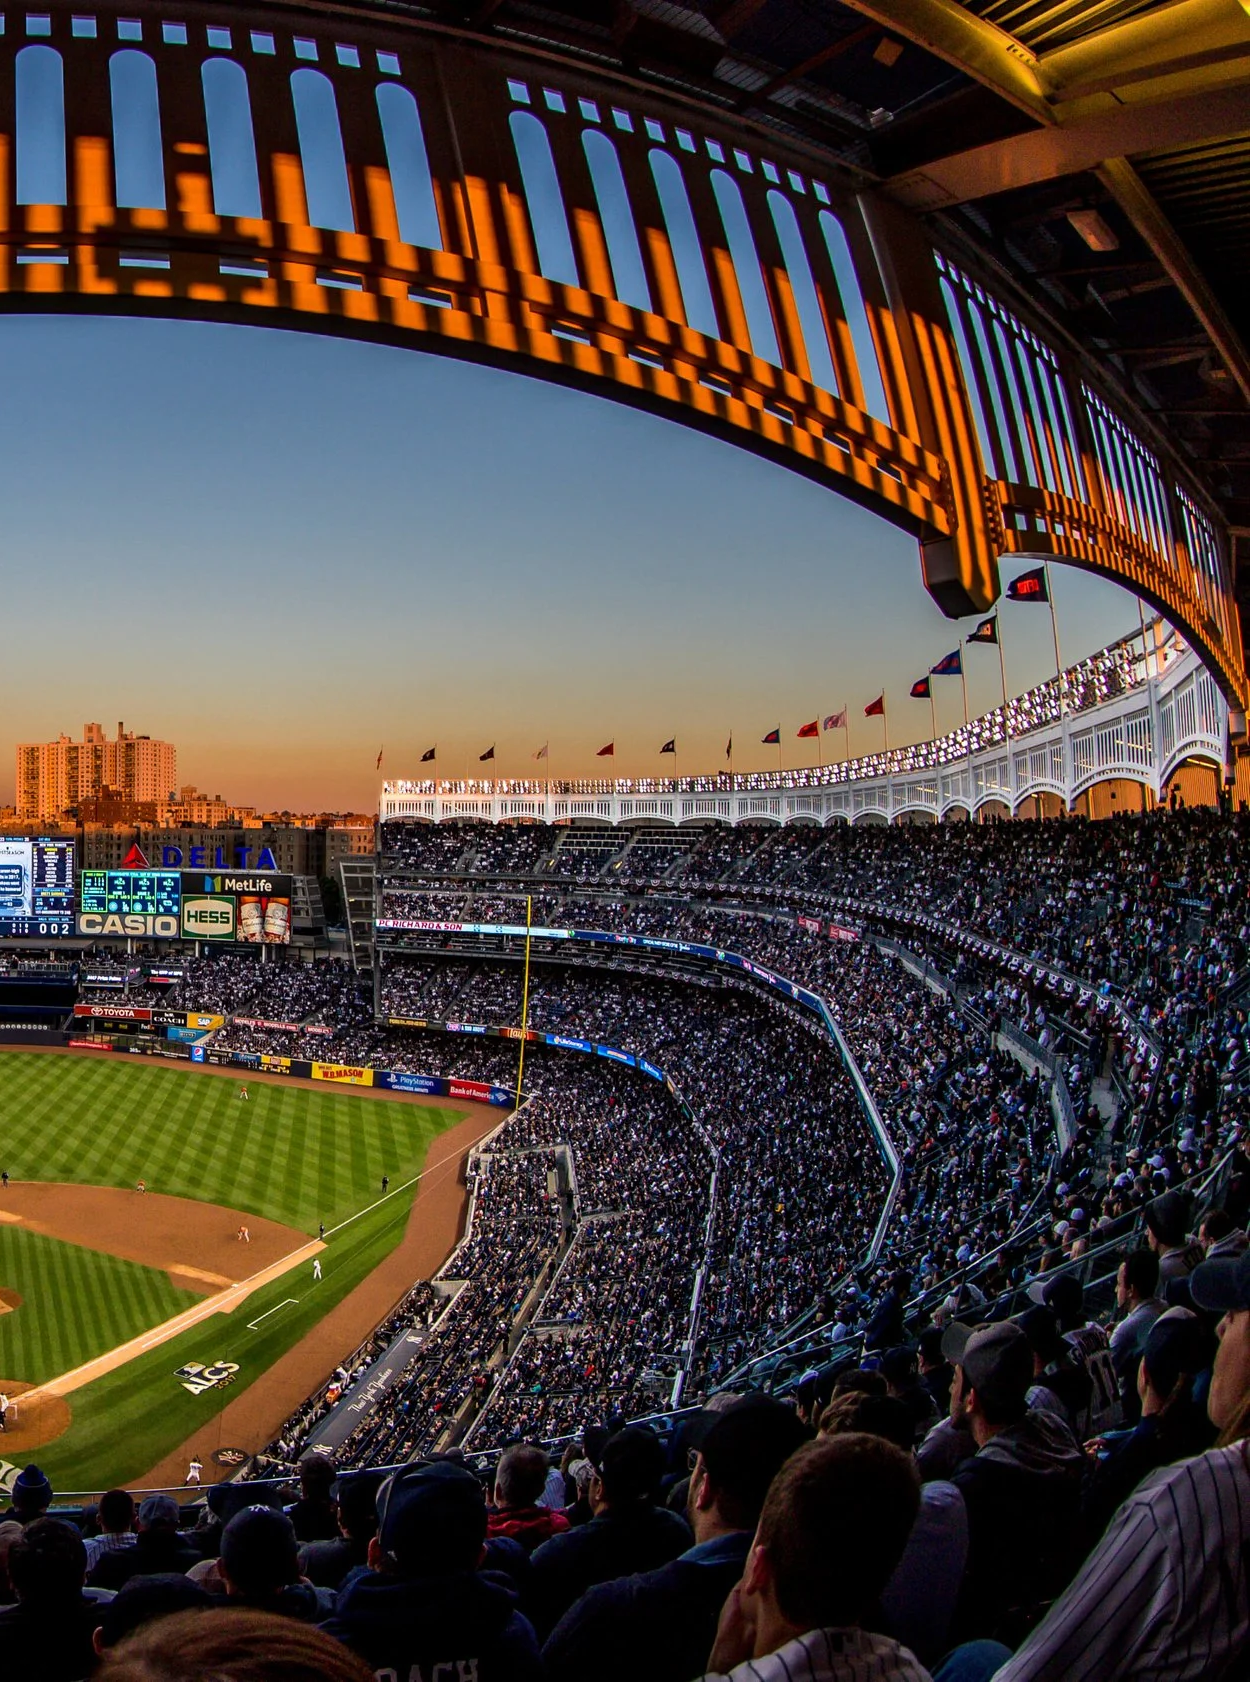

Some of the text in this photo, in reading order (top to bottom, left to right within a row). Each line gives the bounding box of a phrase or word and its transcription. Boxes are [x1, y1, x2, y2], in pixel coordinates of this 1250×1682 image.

[162, 846, 278, 870] DELTA
[225, 878, 272, 892] MetLife
[187, 910, 230, 924] HESS
[40, 924, 69, 934] 0 0 2
[79, 914, 177, 936] CASIO
[392, 921, 435, 930] RICHARD
[104, 1009, 135, 1017] TOYOTA
[400, 1076, 434, 1086] PlayStation
[472, 1089, 494, 1100] America
[180, 1360, 240, 1395] ALCS
[214, 1374, 236, 1390] 2017
[347, 1368, 393, 1412] New York Yankees
